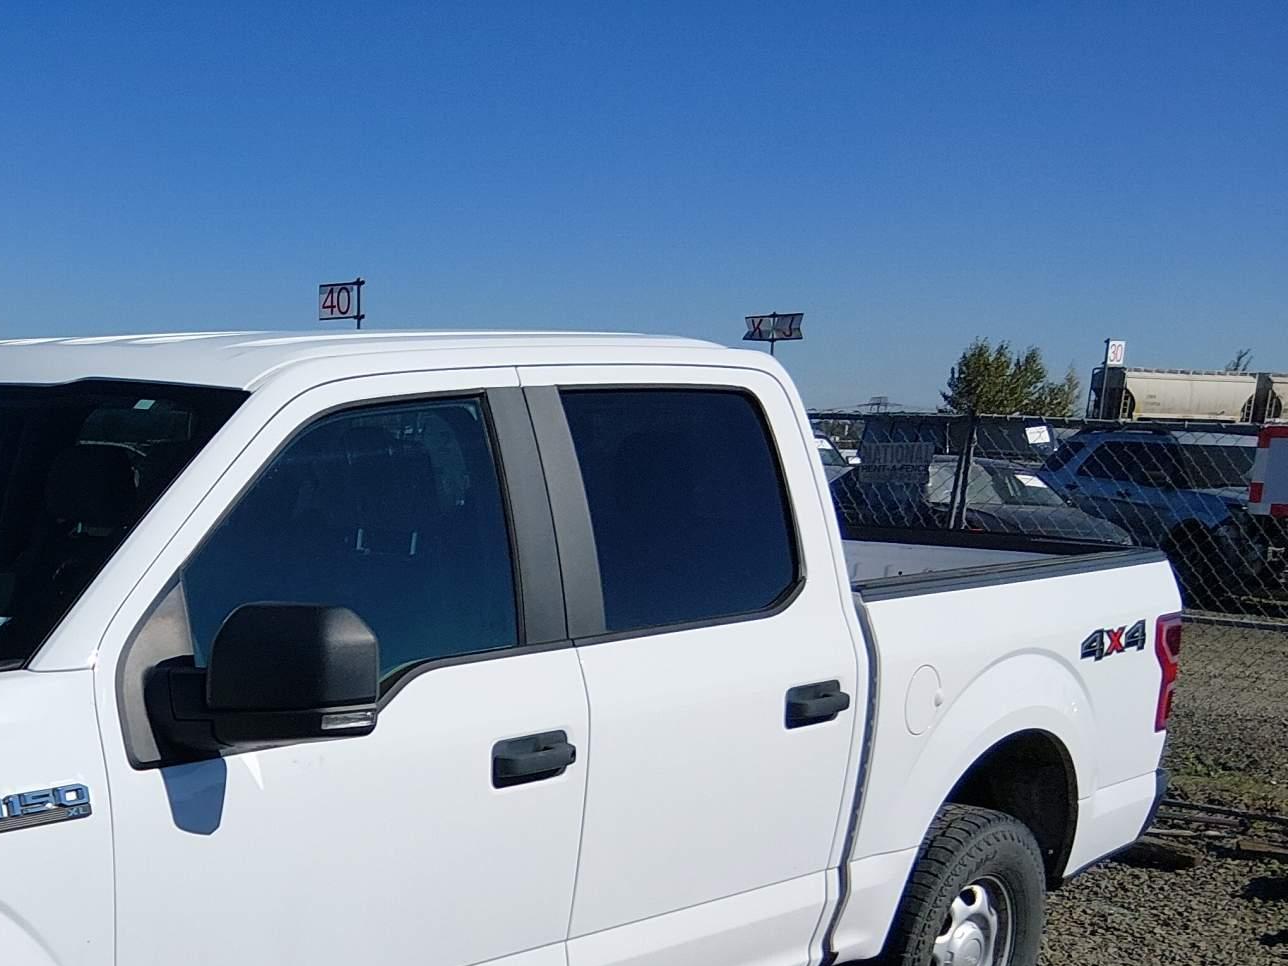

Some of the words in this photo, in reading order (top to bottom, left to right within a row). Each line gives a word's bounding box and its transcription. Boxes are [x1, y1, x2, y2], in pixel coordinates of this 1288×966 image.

[322, 286, 351, 316] 40
[1108, 343, 1124, 362] 30
[68, 804, 89, 817] XL
